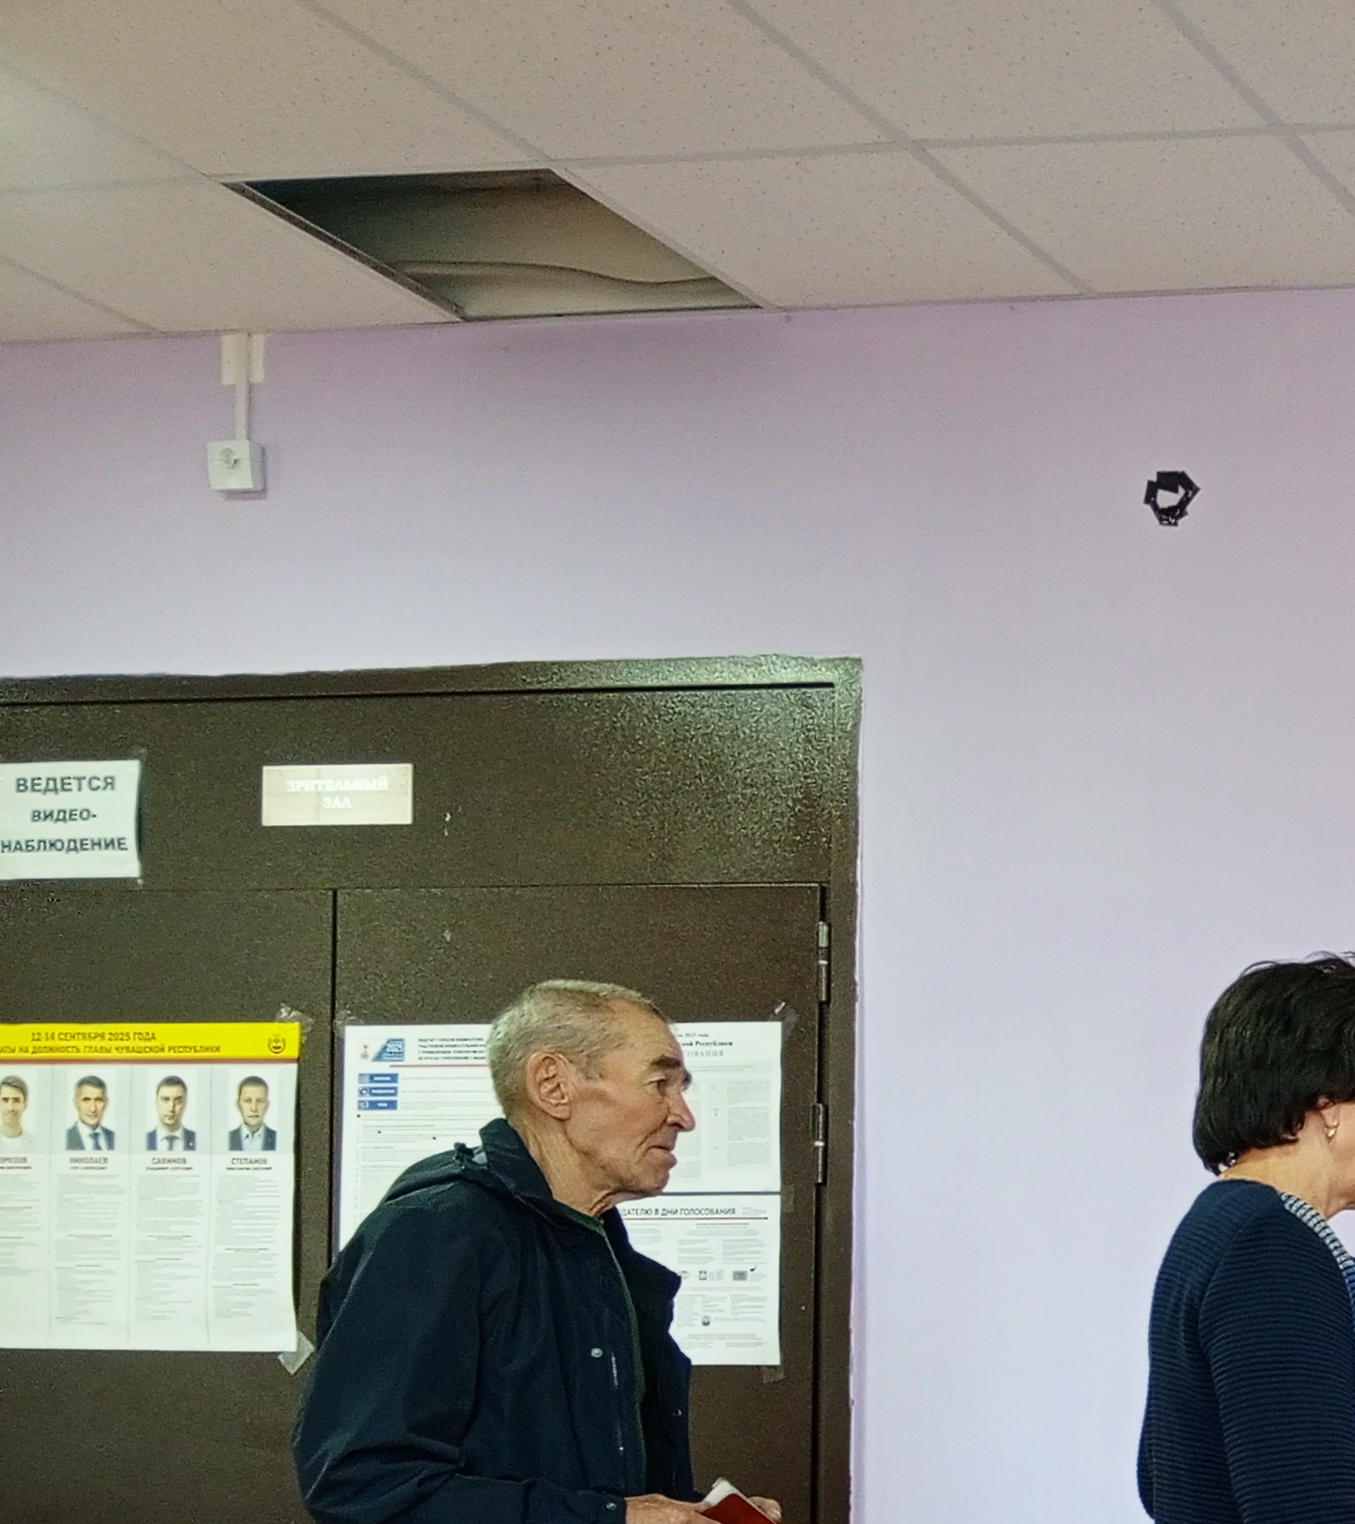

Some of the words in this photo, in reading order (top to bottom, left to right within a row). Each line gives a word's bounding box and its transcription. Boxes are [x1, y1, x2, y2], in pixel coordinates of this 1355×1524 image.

[15, 775, 116, 795] ВЕДЕТСЯ
[322, 796, 352, 809] ЗАЛ
[31, 807, 97, 823] ВИДЕО-
[0, 836, 129, 854] НАБЛЮДЕНИЕ
[58, 1032, 105, 1041] СЕНТЯБРЯ
[107, 1032, 131, 1041] 2025
[133, 1032, 157, 1042] ГОДА
[661, 1208, 679, 1216] ДНИ
[680, 1207, 736, 1215] ГОЛОСОВАНИЯ
